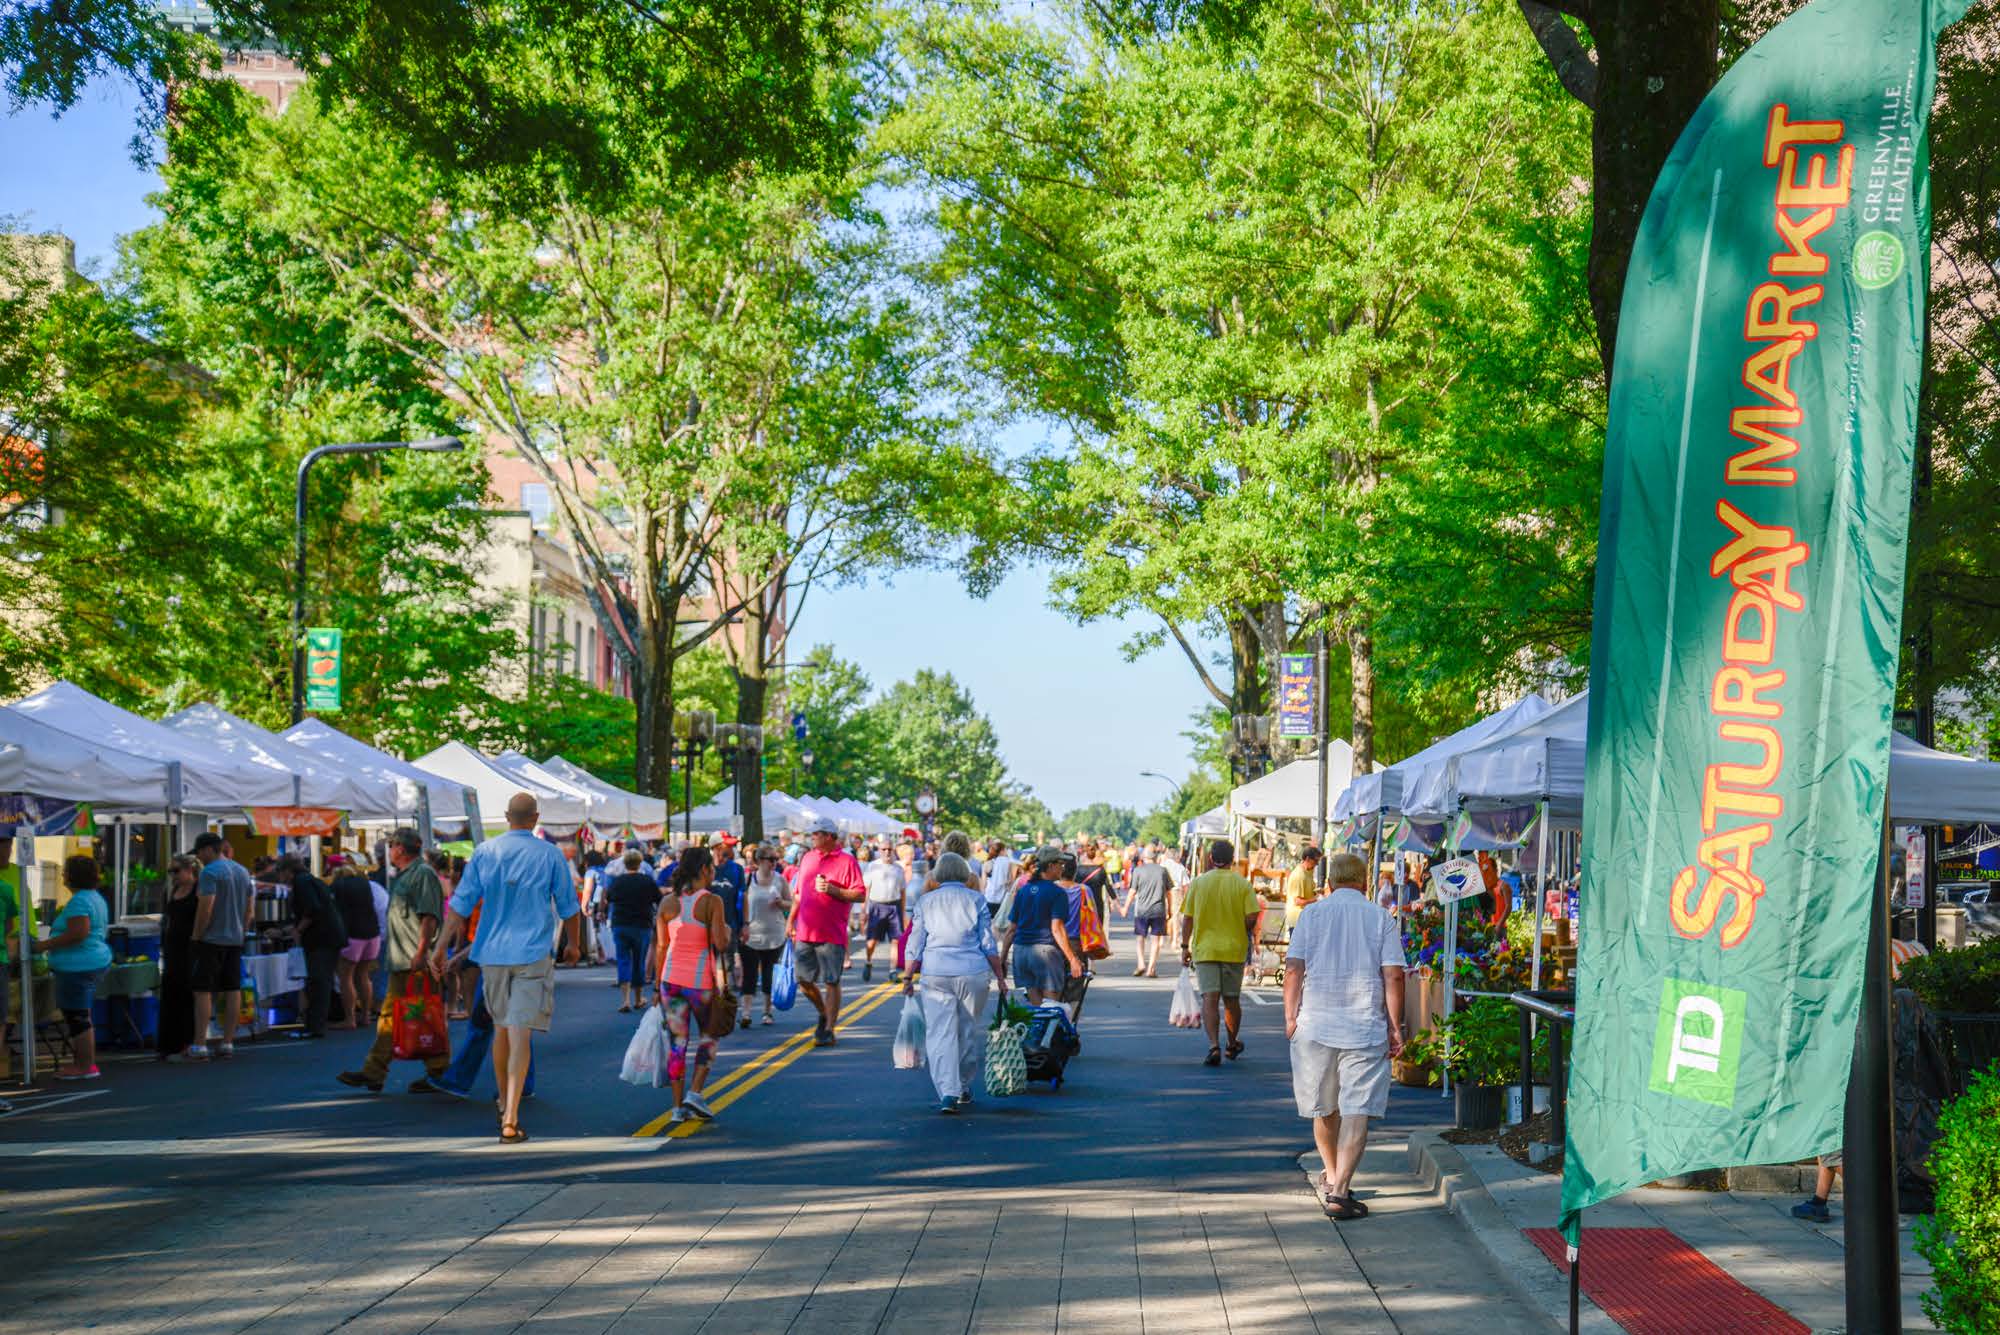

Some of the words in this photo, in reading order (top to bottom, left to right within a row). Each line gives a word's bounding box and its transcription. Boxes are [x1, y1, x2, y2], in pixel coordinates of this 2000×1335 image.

[1863, 86, 1902, 223] GREENVILLE
[1885, 136, 1913, 223] HEALTH
[1723, 102, 1857, 486] MARKET
[1670, 497, 1810, 950] SATURDAY
[1667, 994, 1725, 1086] TD
